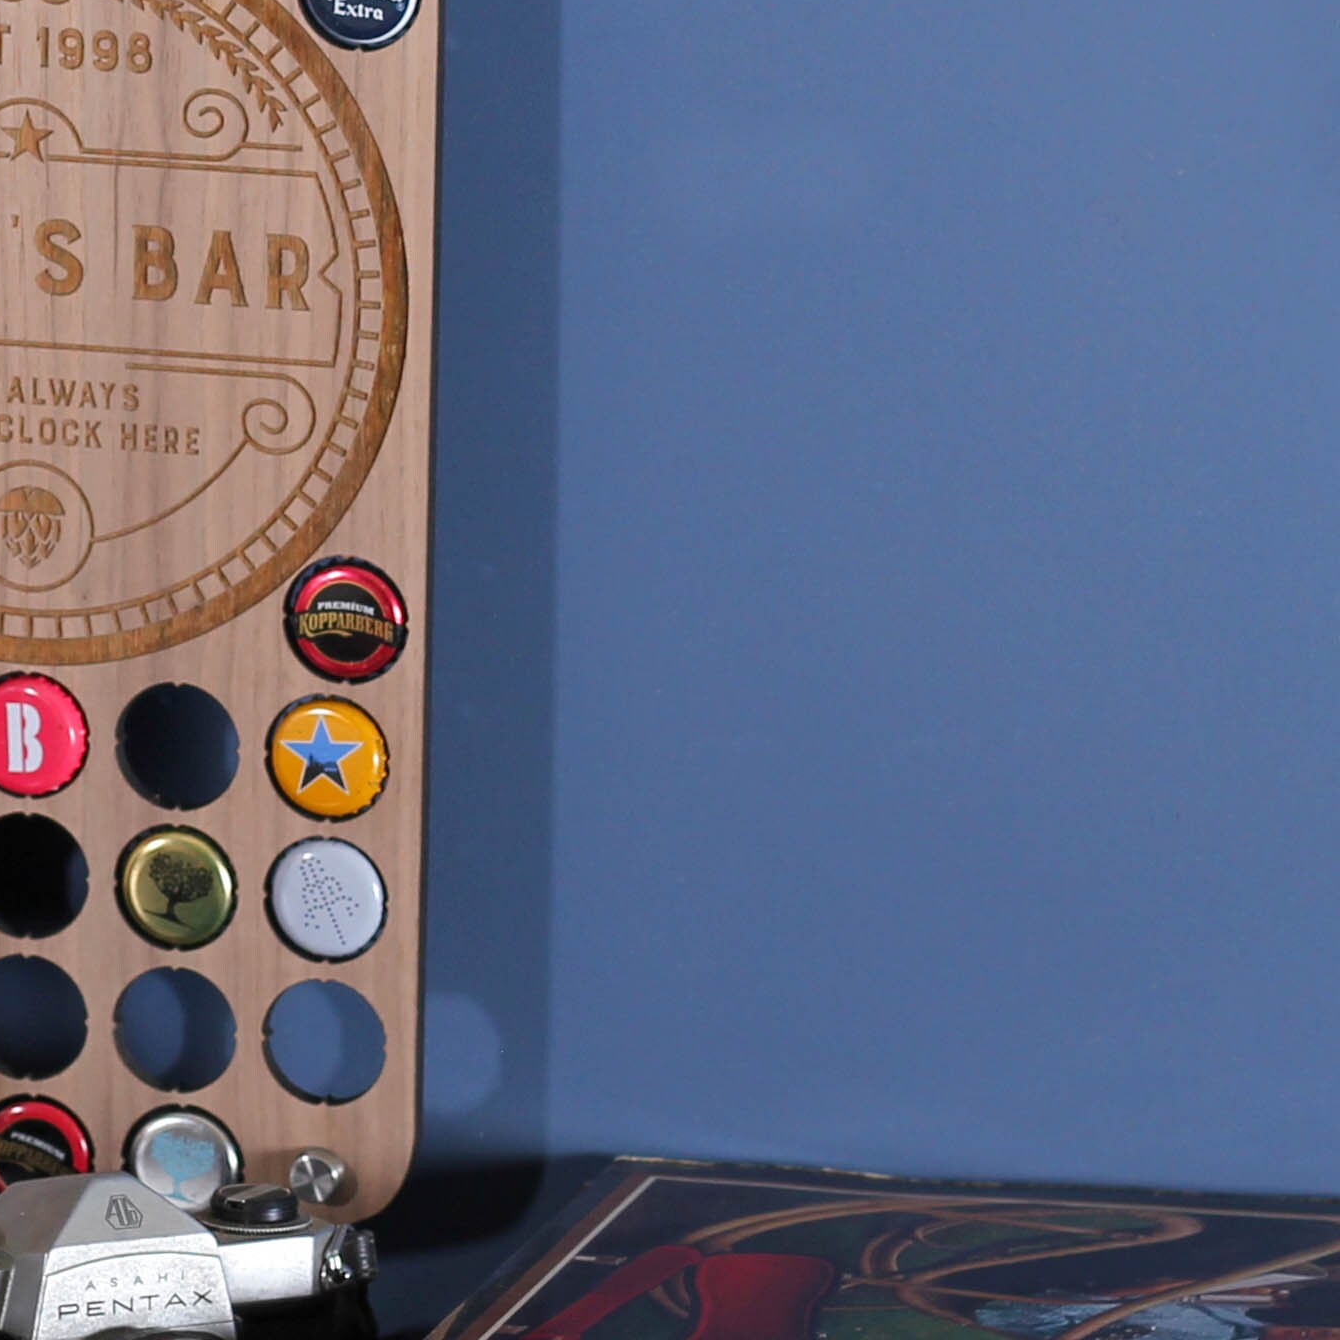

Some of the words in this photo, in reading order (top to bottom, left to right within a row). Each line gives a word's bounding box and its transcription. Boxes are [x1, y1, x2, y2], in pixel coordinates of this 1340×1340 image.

[36, 25, 153, 74] 1998
[131, 224, 311, 311] BAR
[6, 375, 140, 412] ALWAYS
[120, 422, 201, 456] HERE
[316, 600, 375, 616] PREMIUM
[298, 611, 394, 643] KOPPARBERG
[5, 702, 45, 773] B
[85, 1270, 185, 1291] ASAHI
[57, 1289, 214, 1321] PENTAX
